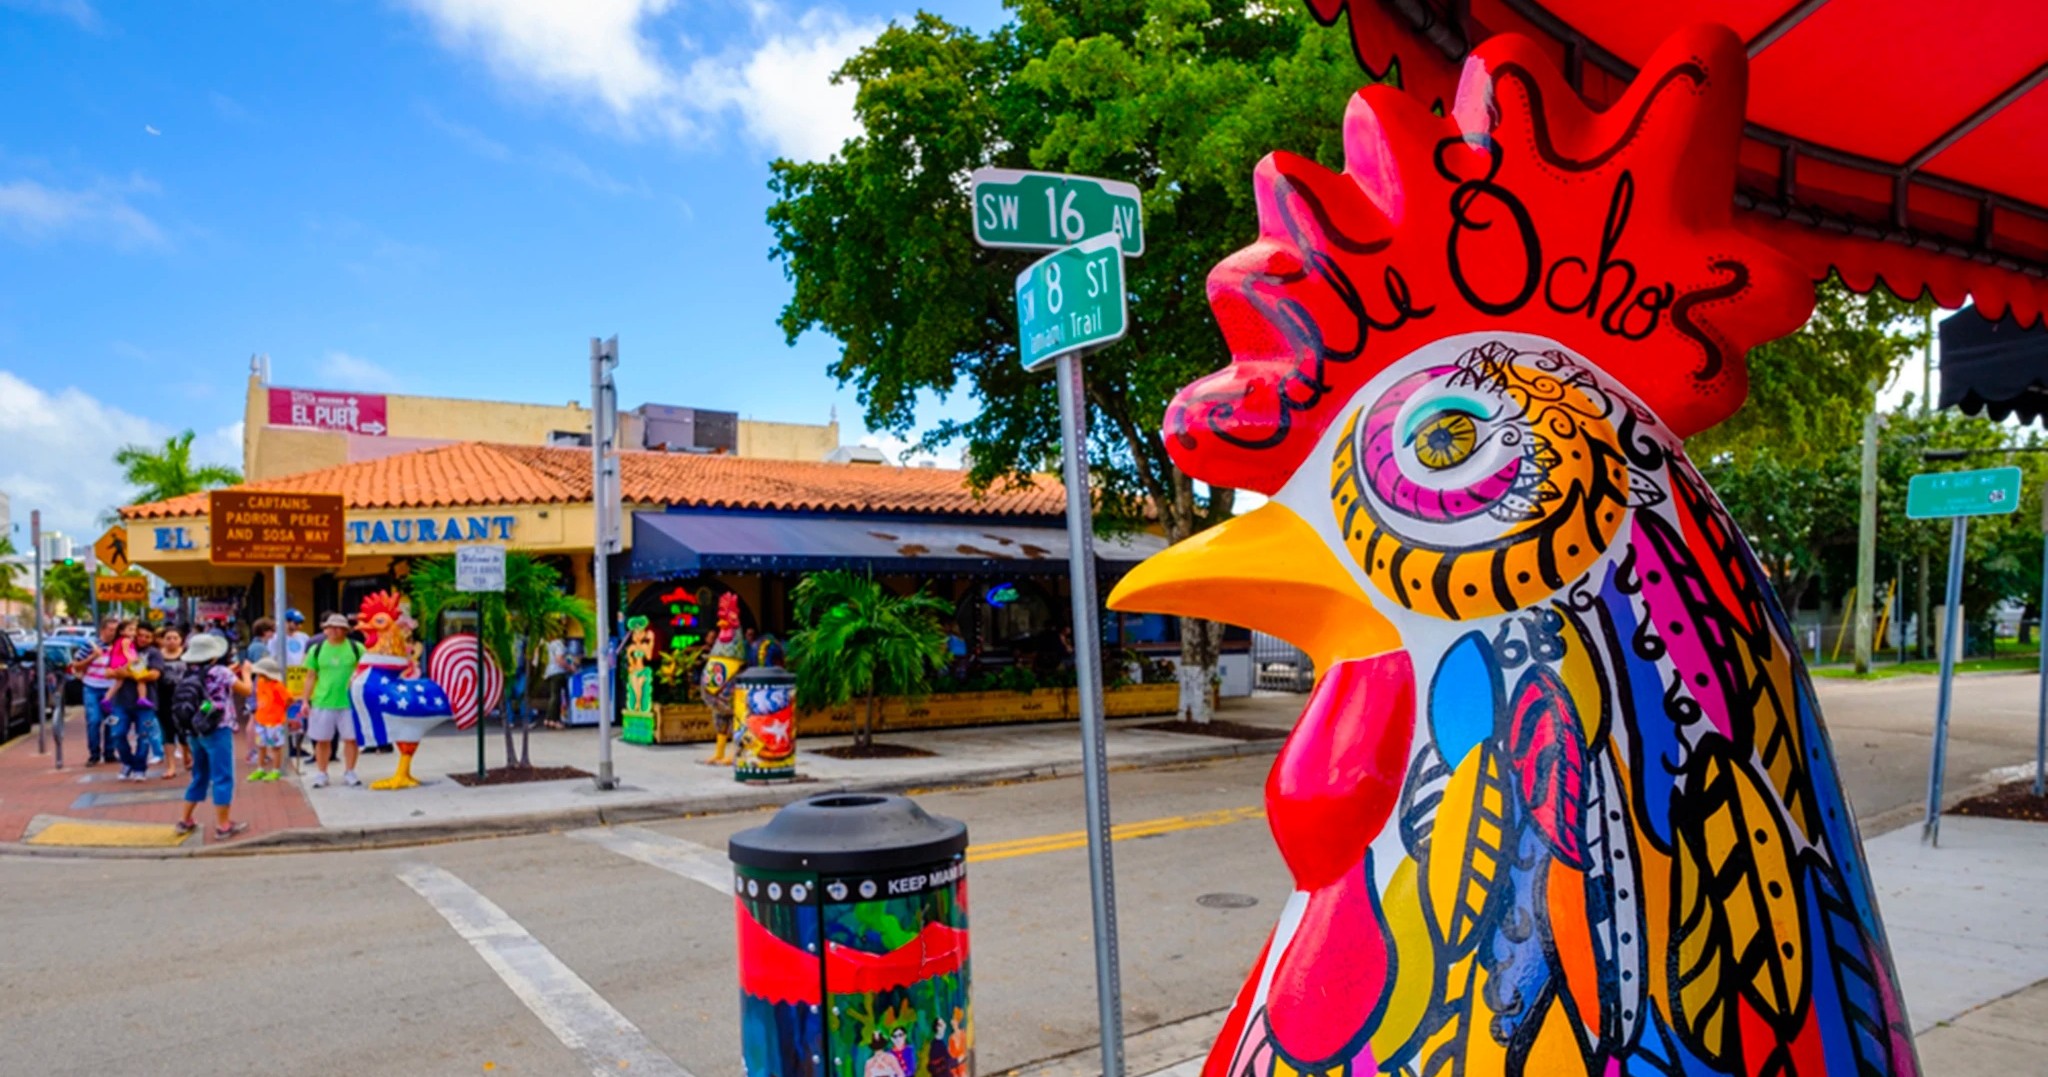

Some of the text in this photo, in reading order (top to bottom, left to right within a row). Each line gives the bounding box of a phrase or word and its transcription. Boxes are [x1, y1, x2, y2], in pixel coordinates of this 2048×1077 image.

[982, 187, 1133, 240] SW 16 AV
[1046, 261, 1063, 315] 8
[1085, 257, 1108, 298] ST
[1207, 136, 1675, 451] Calle Ocho
[1070, 305, 1102, 338] Trail
[292, 404, 312, 425] EL
[154, 515, 515, 550] EL TAURANT
[290, 513, 330, 527] PEREZ
[226, 528, 330, 542] AND SOSA WAY
[98, 582, 146, 595] AHEAD
[888, 874, 927, 895] KEEP
